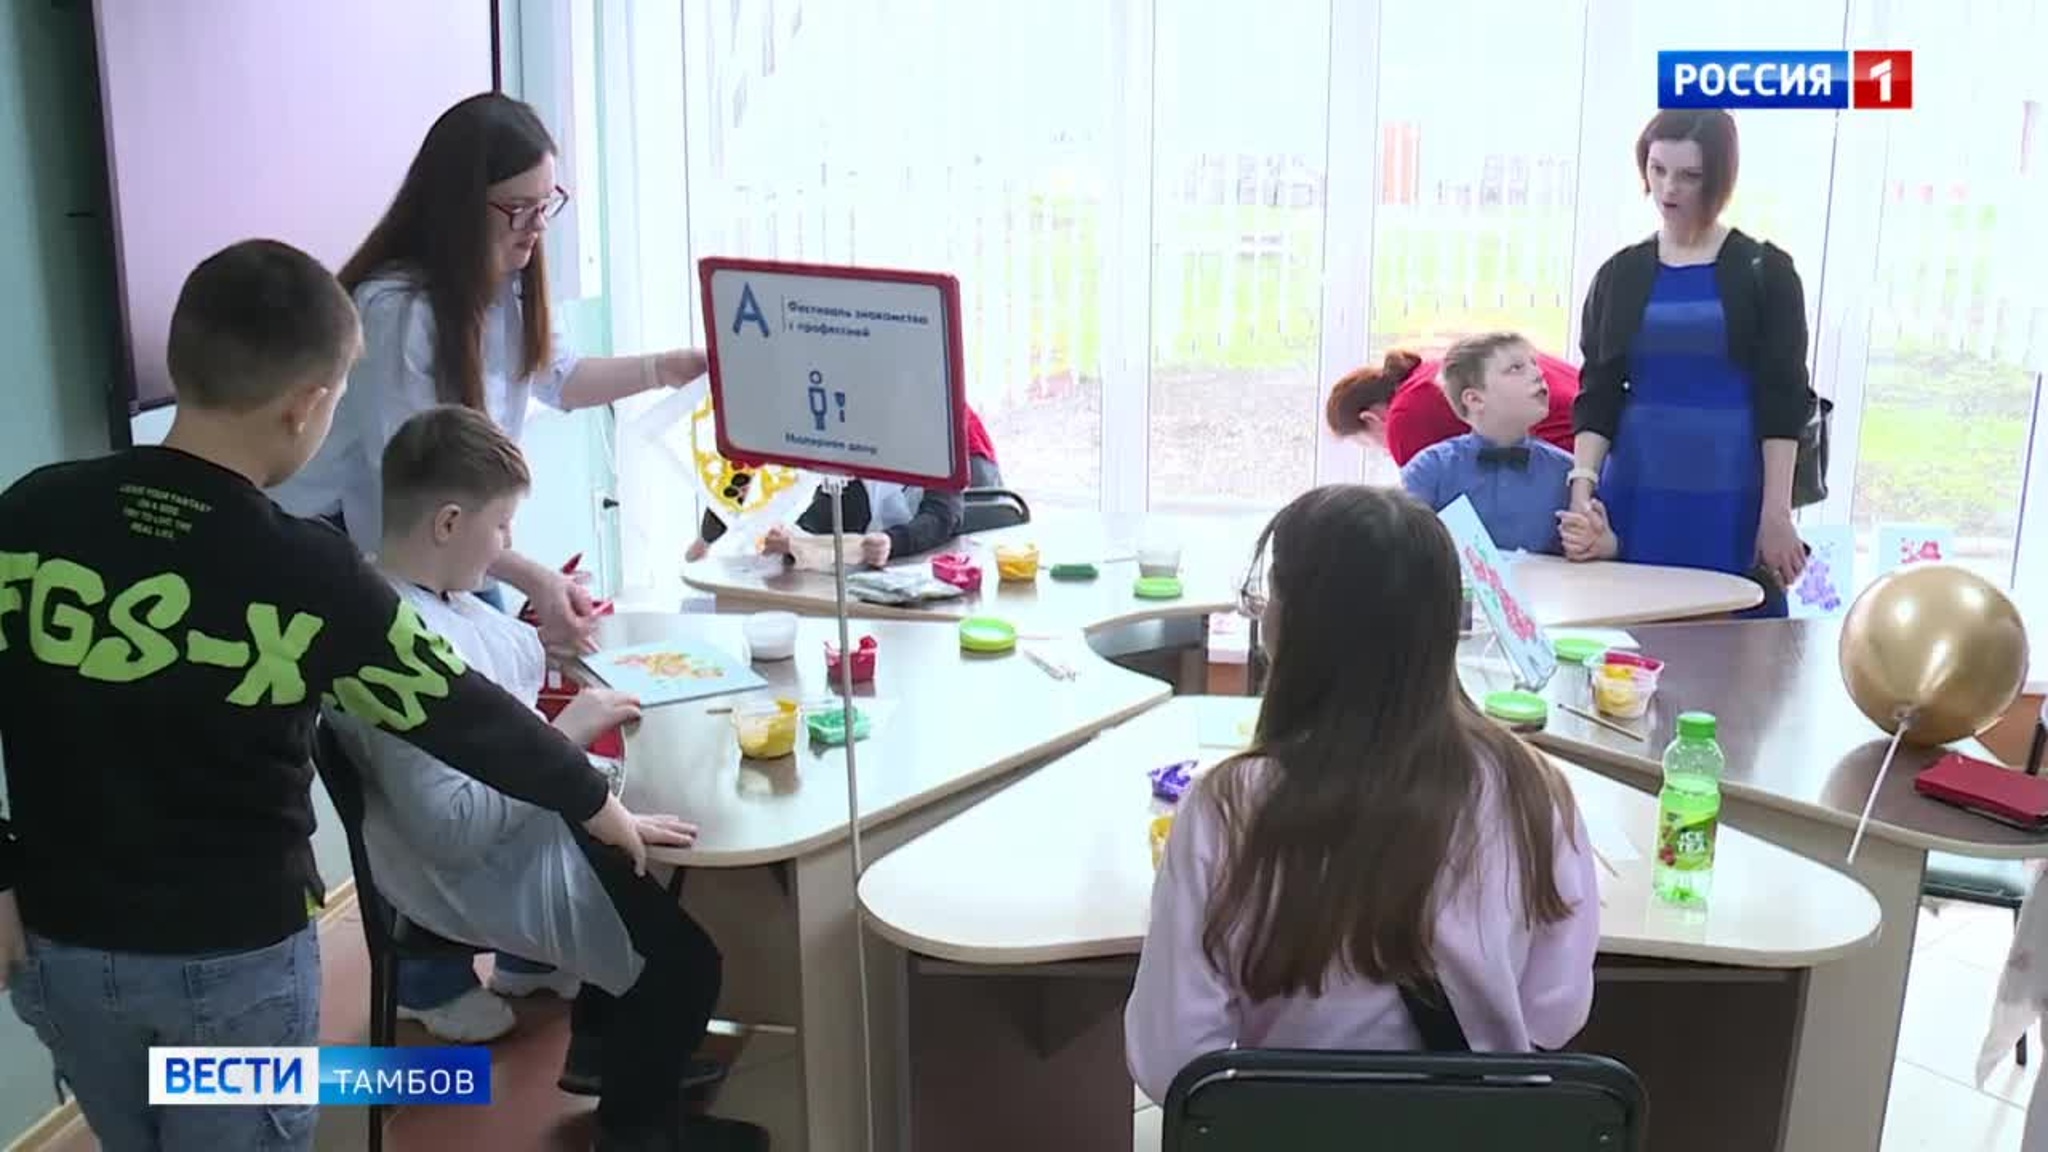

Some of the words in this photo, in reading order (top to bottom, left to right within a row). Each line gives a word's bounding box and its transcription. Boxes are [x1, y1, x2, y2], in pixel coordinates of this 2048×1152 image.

[787, 300, 852, 319] Фестиваль
[797, 323, 871, 338] профессией
[1676, 841, 1706, 854] TEA
